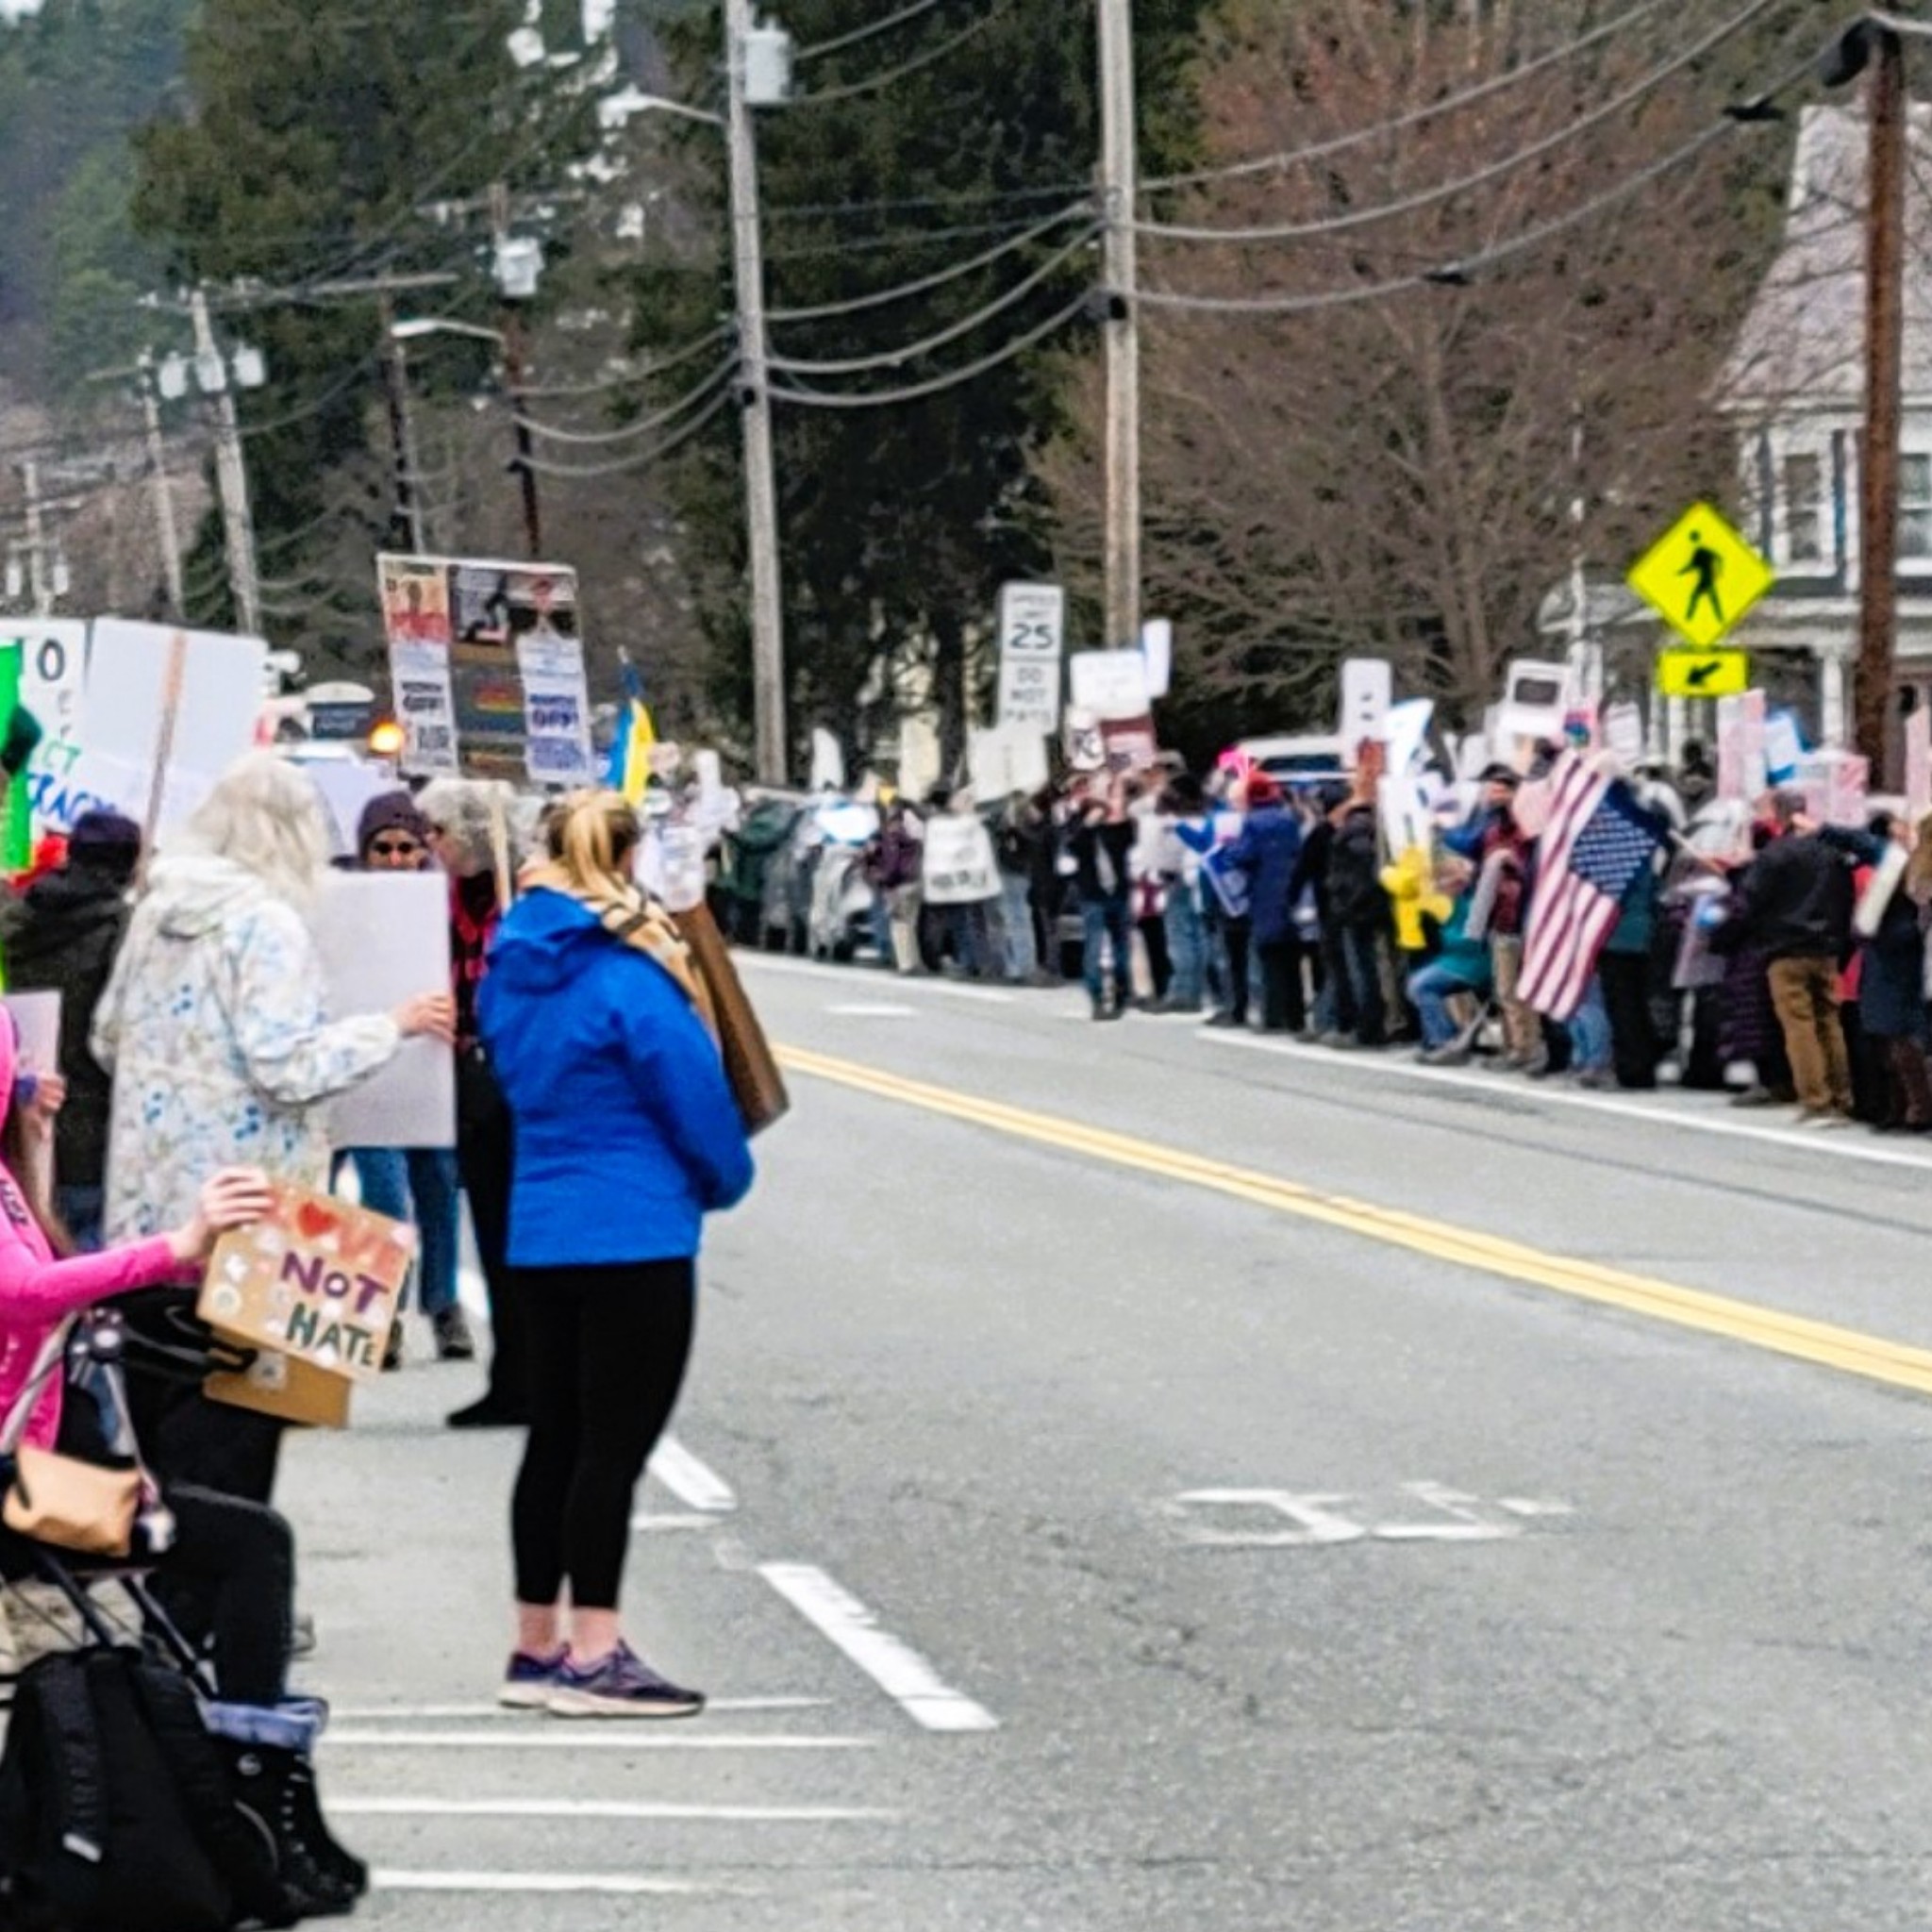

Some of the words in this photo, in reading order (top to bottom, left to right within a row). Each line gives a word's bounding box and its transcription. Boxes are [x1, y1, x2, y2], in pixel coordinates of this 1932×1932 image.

[1010, 623, 1054, 650] 25
[1017, 668, 1042, 683] DO
[1010, 689, 1047, 703] NOT
[280, 1250, 390, 1313] NOT
[285, 1301, 376, 1367] HATE
